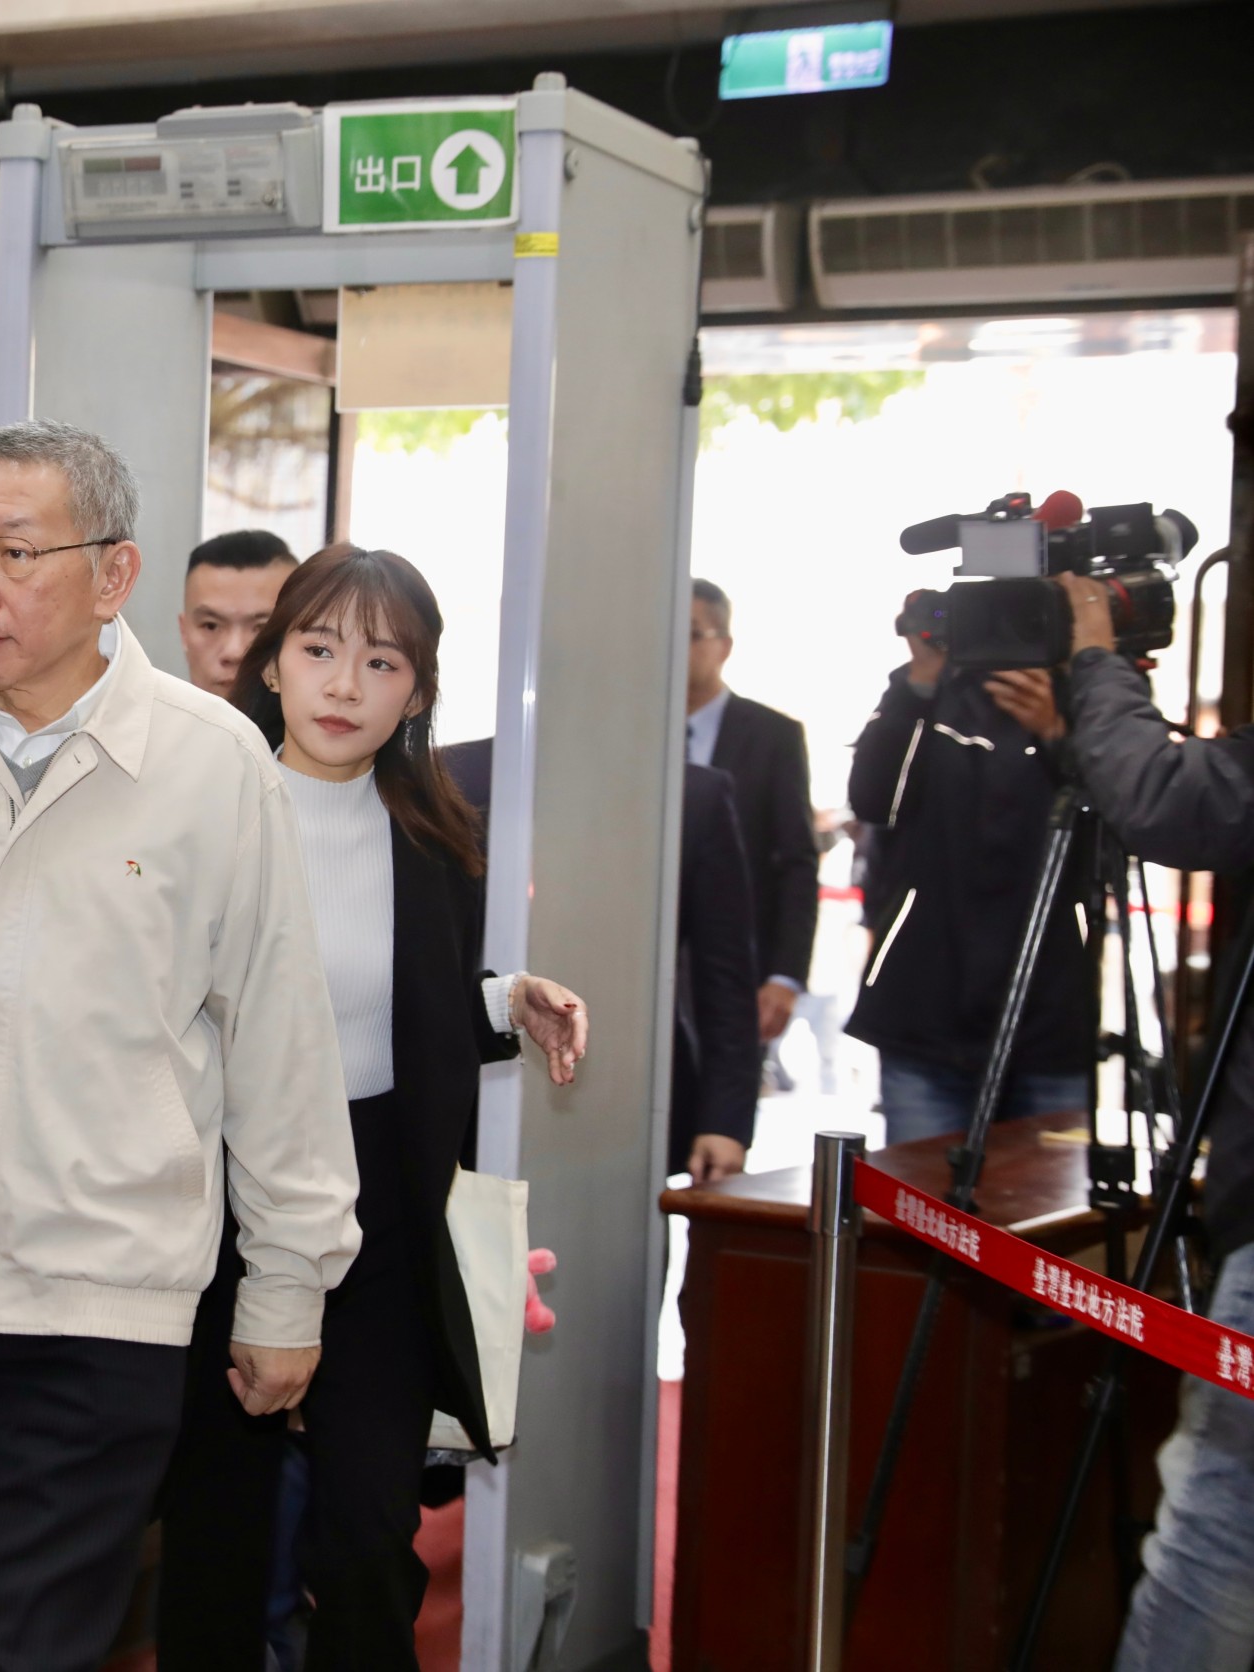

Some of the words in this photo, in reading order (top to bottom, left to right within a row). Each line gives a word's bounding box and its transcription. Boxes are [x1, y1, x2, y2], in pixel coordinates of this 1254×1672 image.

[354, 154, 422, 194] 出口
[1031, 1256, 1146, 1344] 臺灣臺北地方法院
[1215, 1334, 1254, 1391] 臺灣
